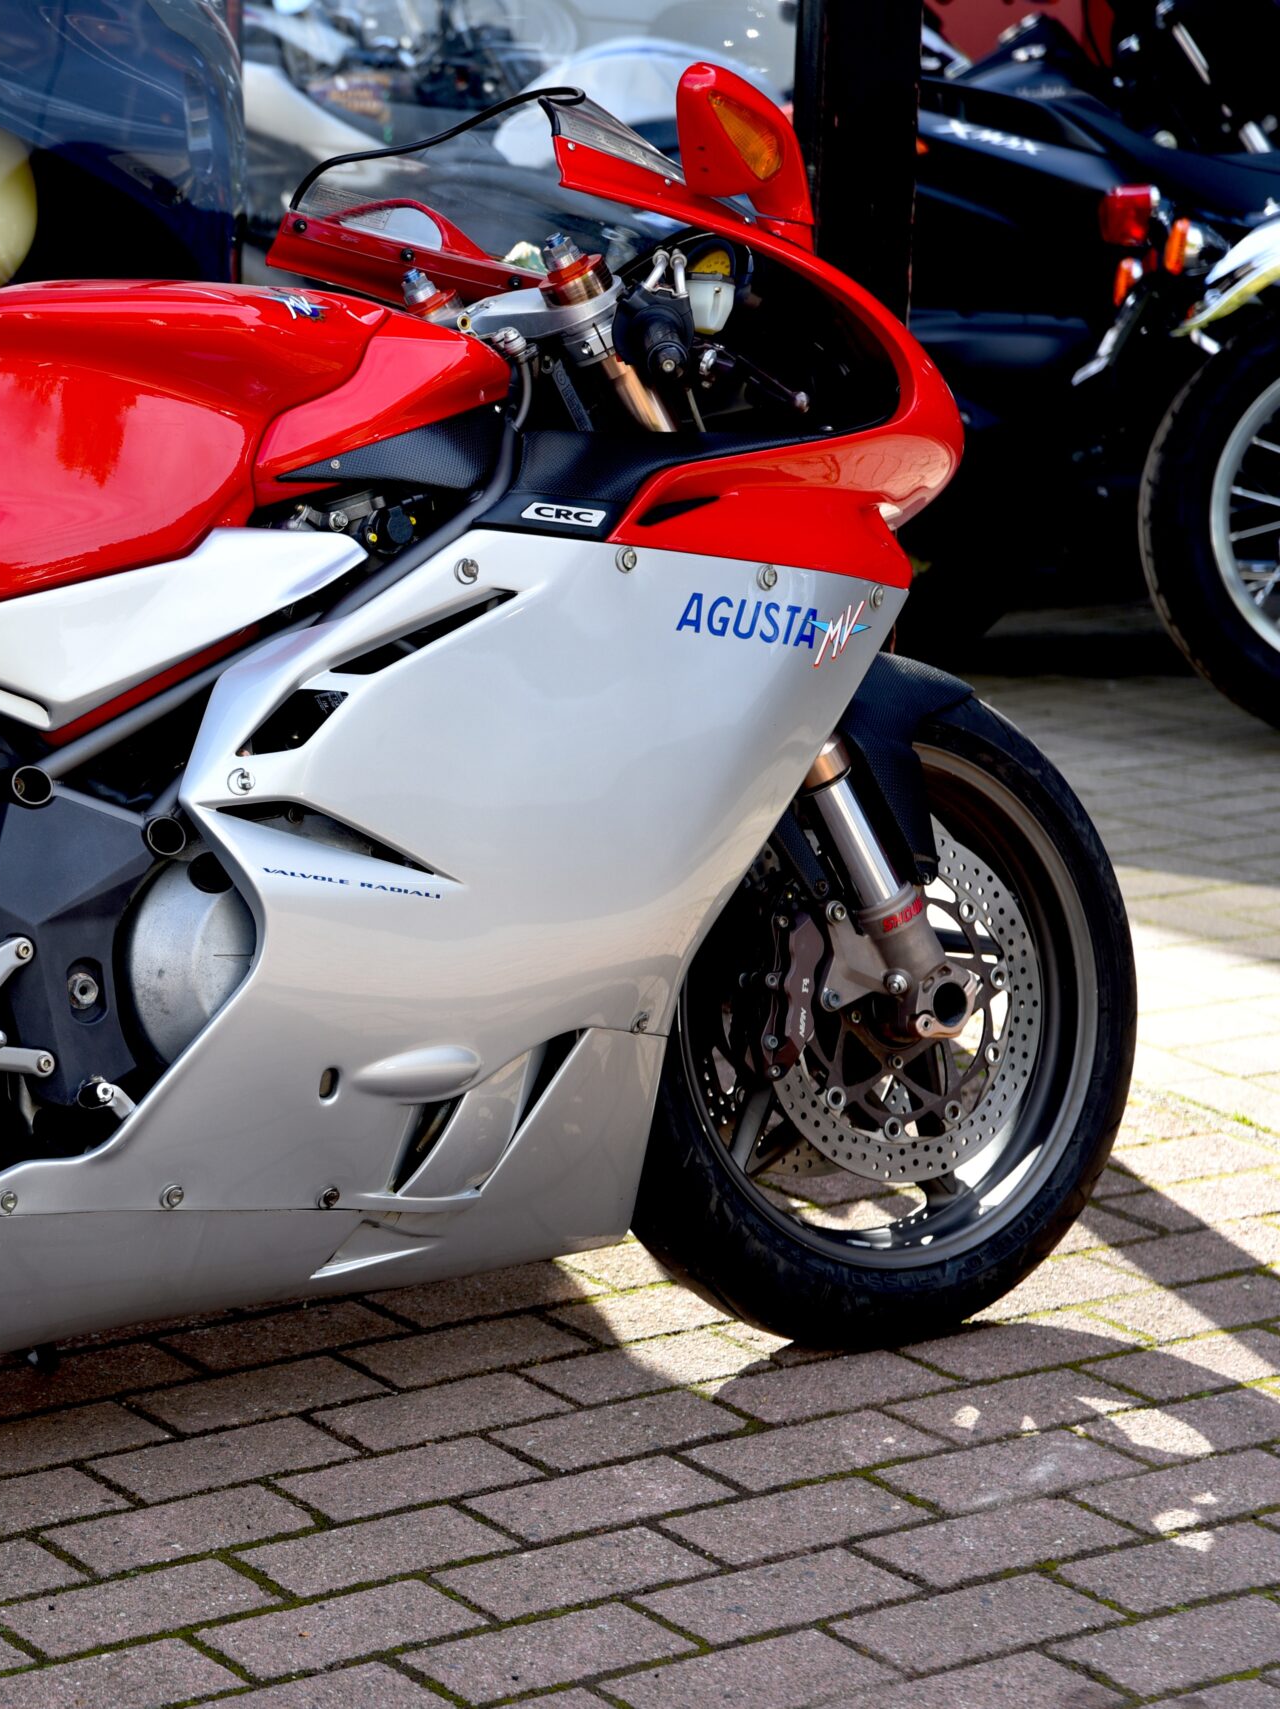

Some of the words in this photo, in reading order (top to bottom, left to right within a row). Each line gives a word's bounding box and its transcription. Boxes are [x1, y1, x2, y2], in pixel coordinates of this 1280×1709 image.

[534, 506, 594, 523] CRC
[676, 592, 818, 649] AGUSTA
[812, 600, 867, 669] MV
[262, 867, 350, 885] VALVOLE
[360, 882, 441, 899] RADIALI
[882, 896, 924, 933] SHOW
